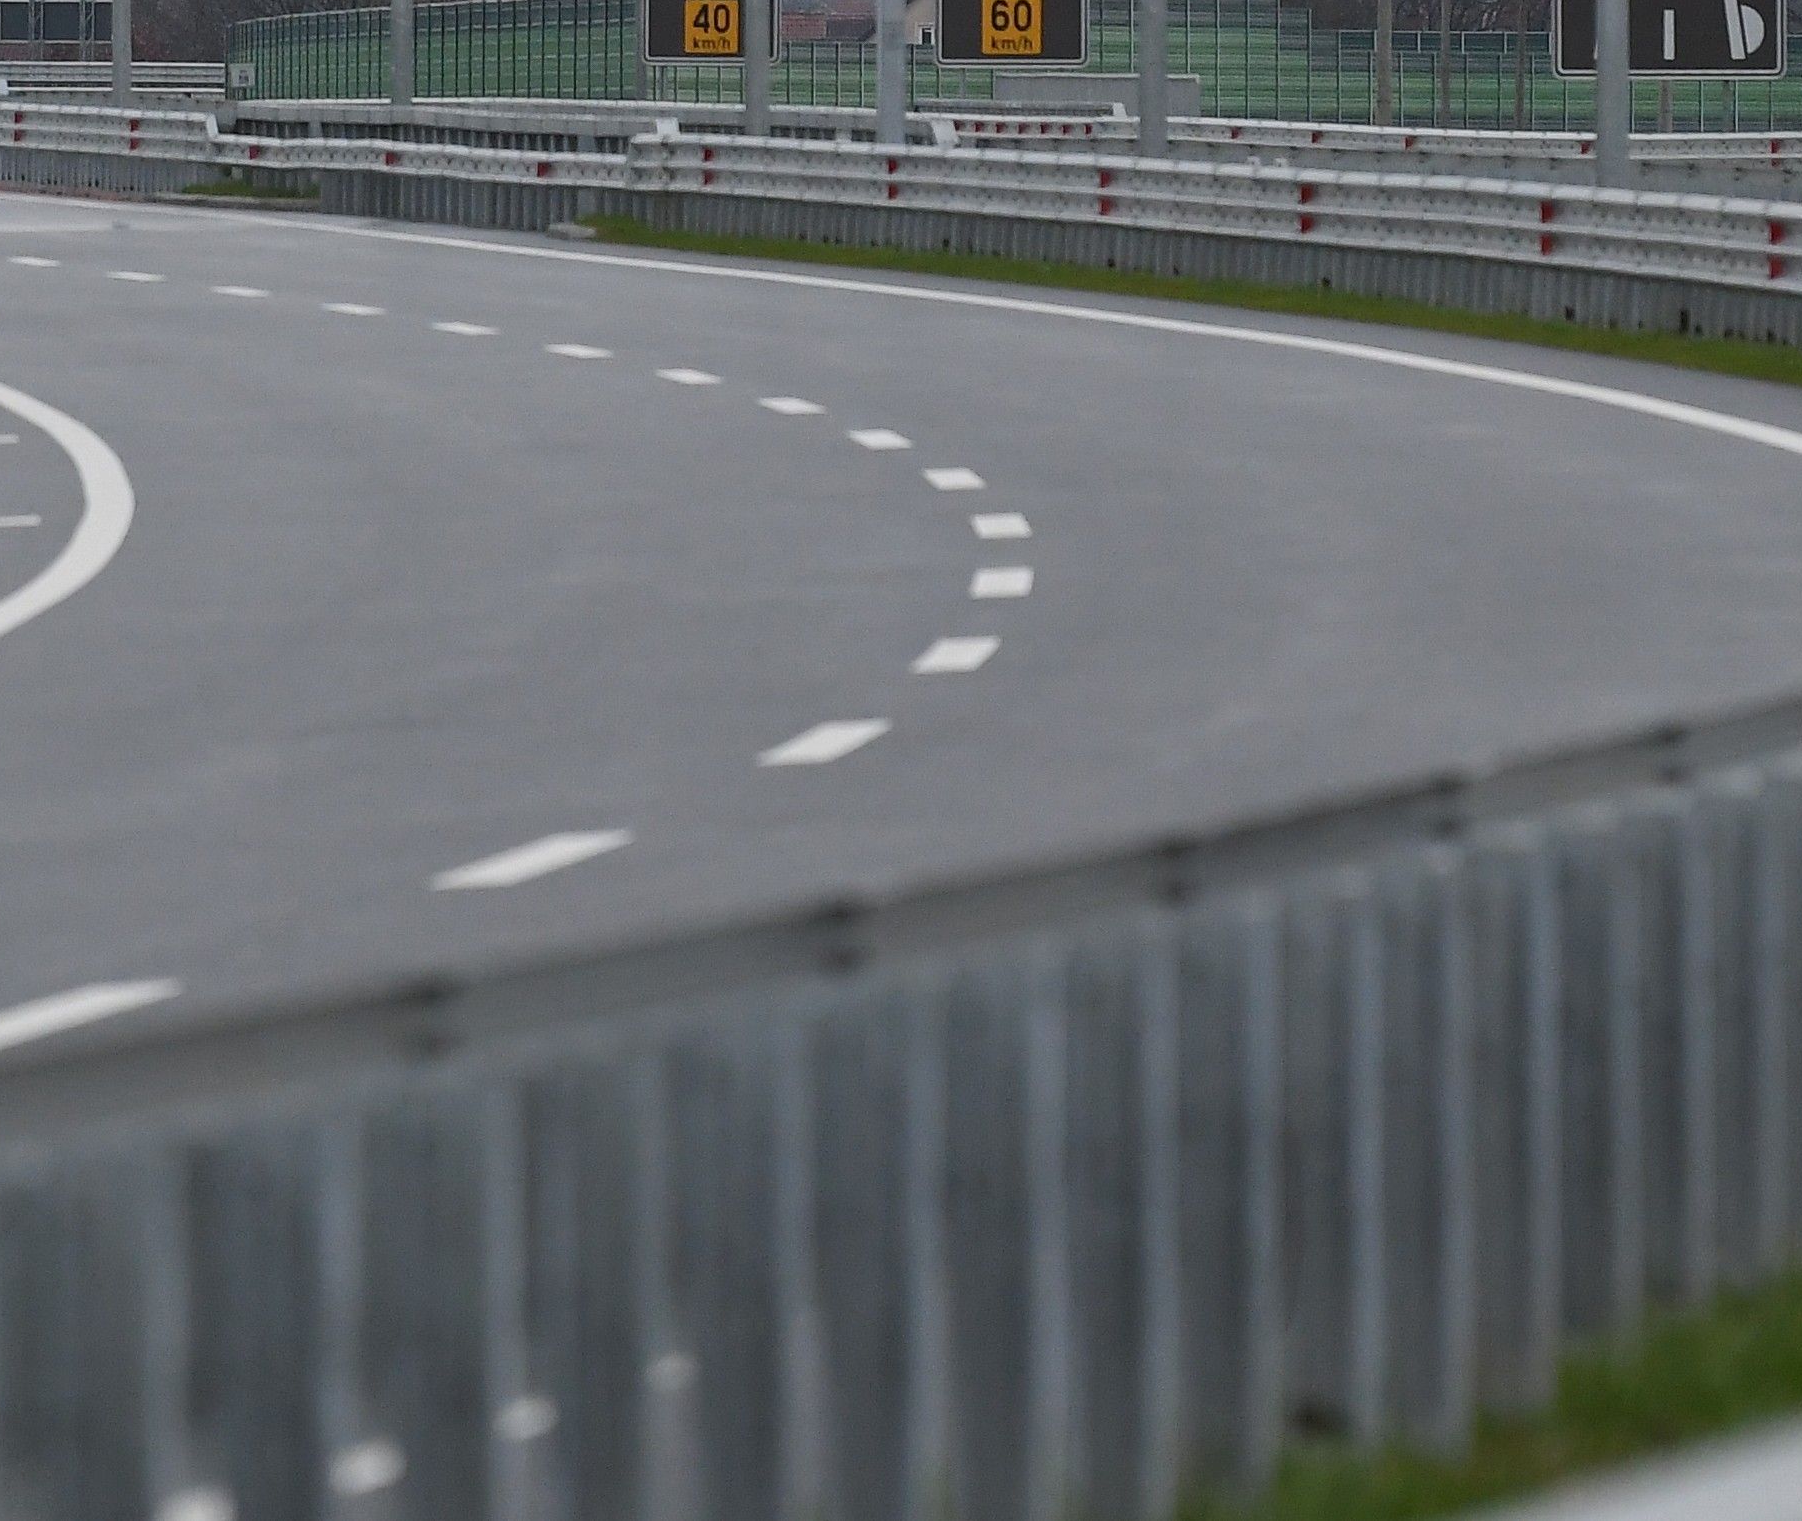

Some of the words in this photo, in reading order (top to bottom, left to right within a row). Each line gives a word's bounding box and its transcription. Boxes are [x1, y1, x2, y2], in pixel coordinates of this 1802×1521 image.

[693, 3, 731, 34] 40
[991, 0, 1032, 32] 60
[692, 36, 731, 51] km/h
[991, 35, 1033, 51] km/h
